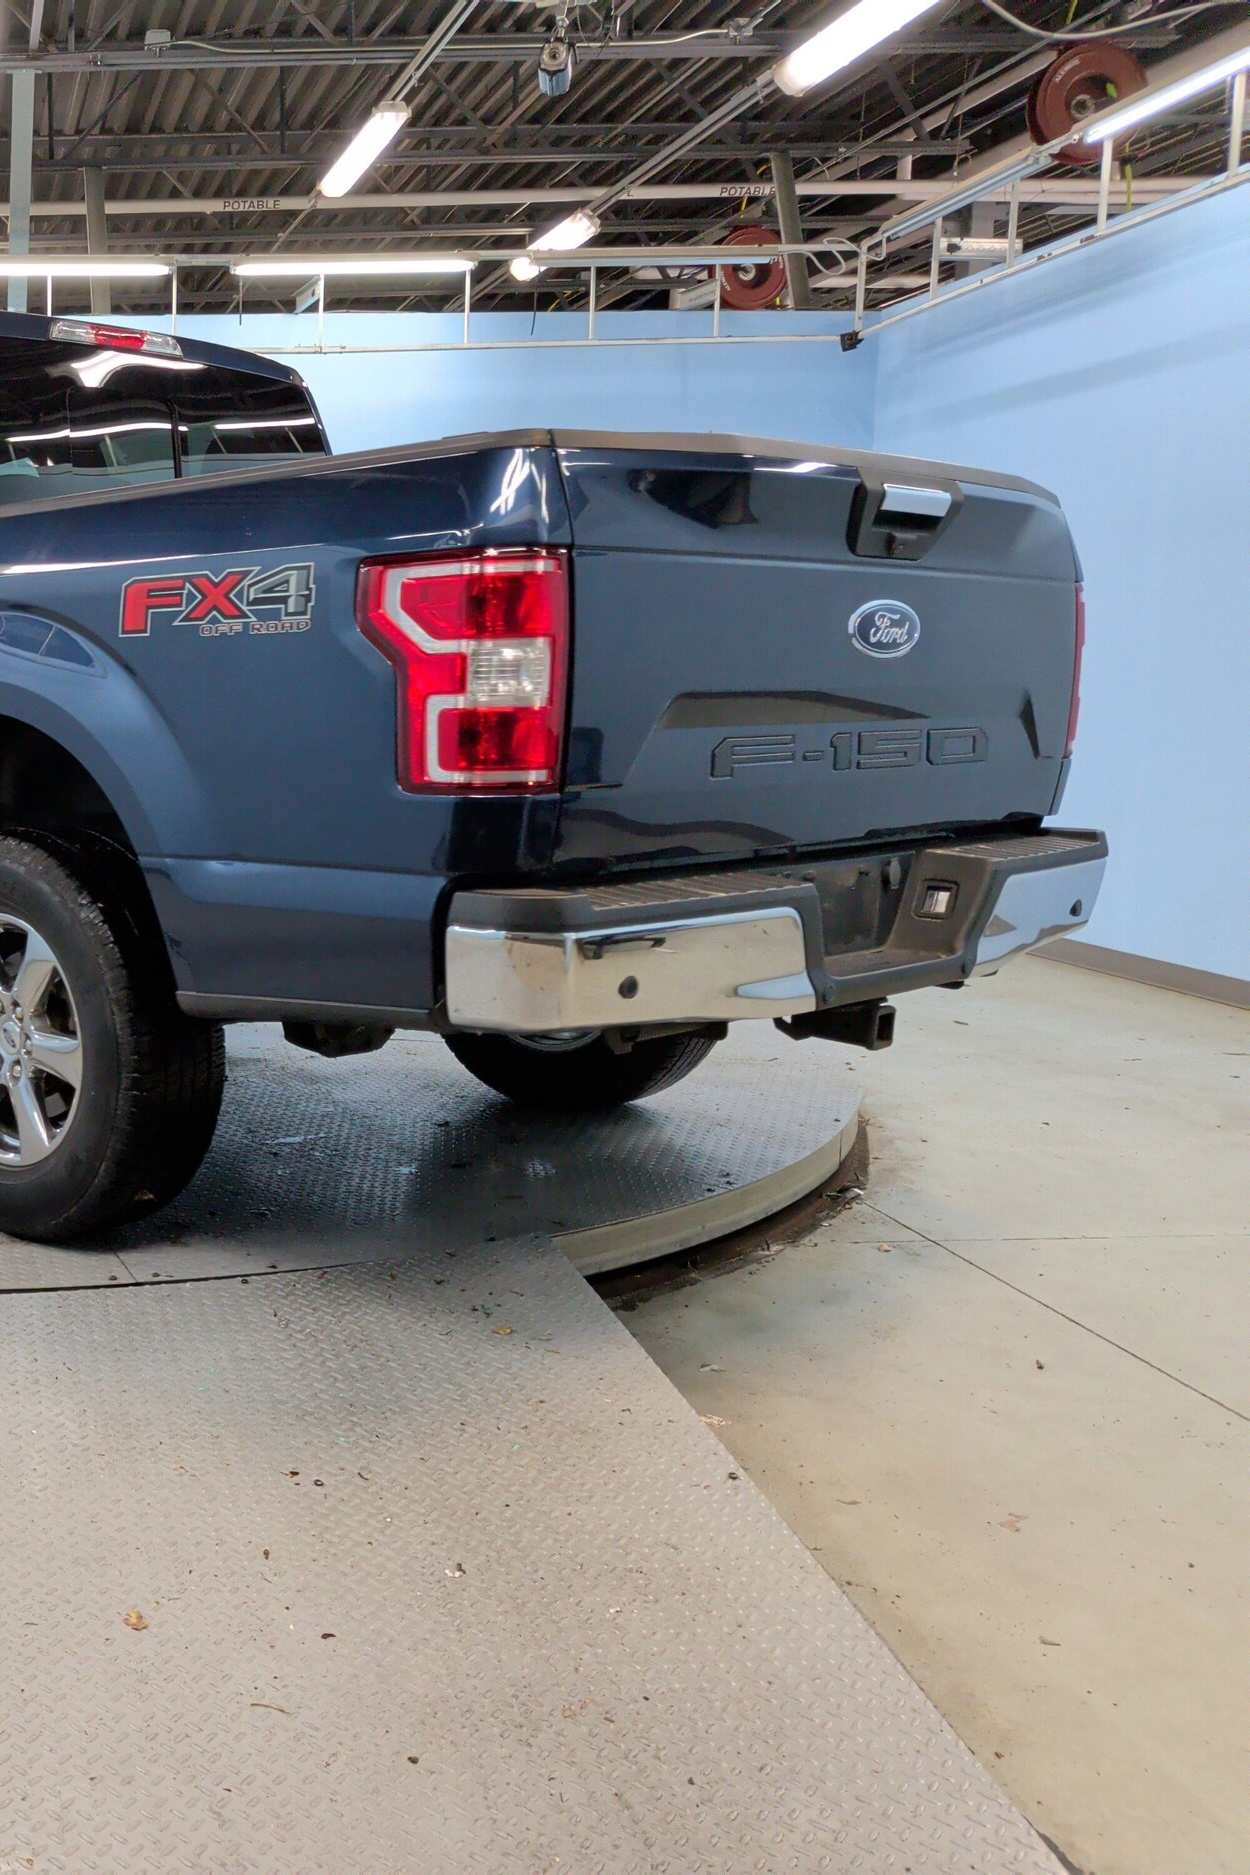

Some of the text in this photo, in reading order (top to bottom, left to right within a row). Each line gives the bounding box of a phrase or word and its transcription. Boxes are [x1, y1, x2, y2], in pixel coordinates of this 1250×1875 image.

[719, 186, 775, 196] POTABLE
[223, 199, 281, 210] POTABLE
[119, 562, 315, 637] FX4
[199, 619, 311, 637] OFF ROAD
[870, 611, 910, 644] Ford
[710, 726, 988, 780] F-150
